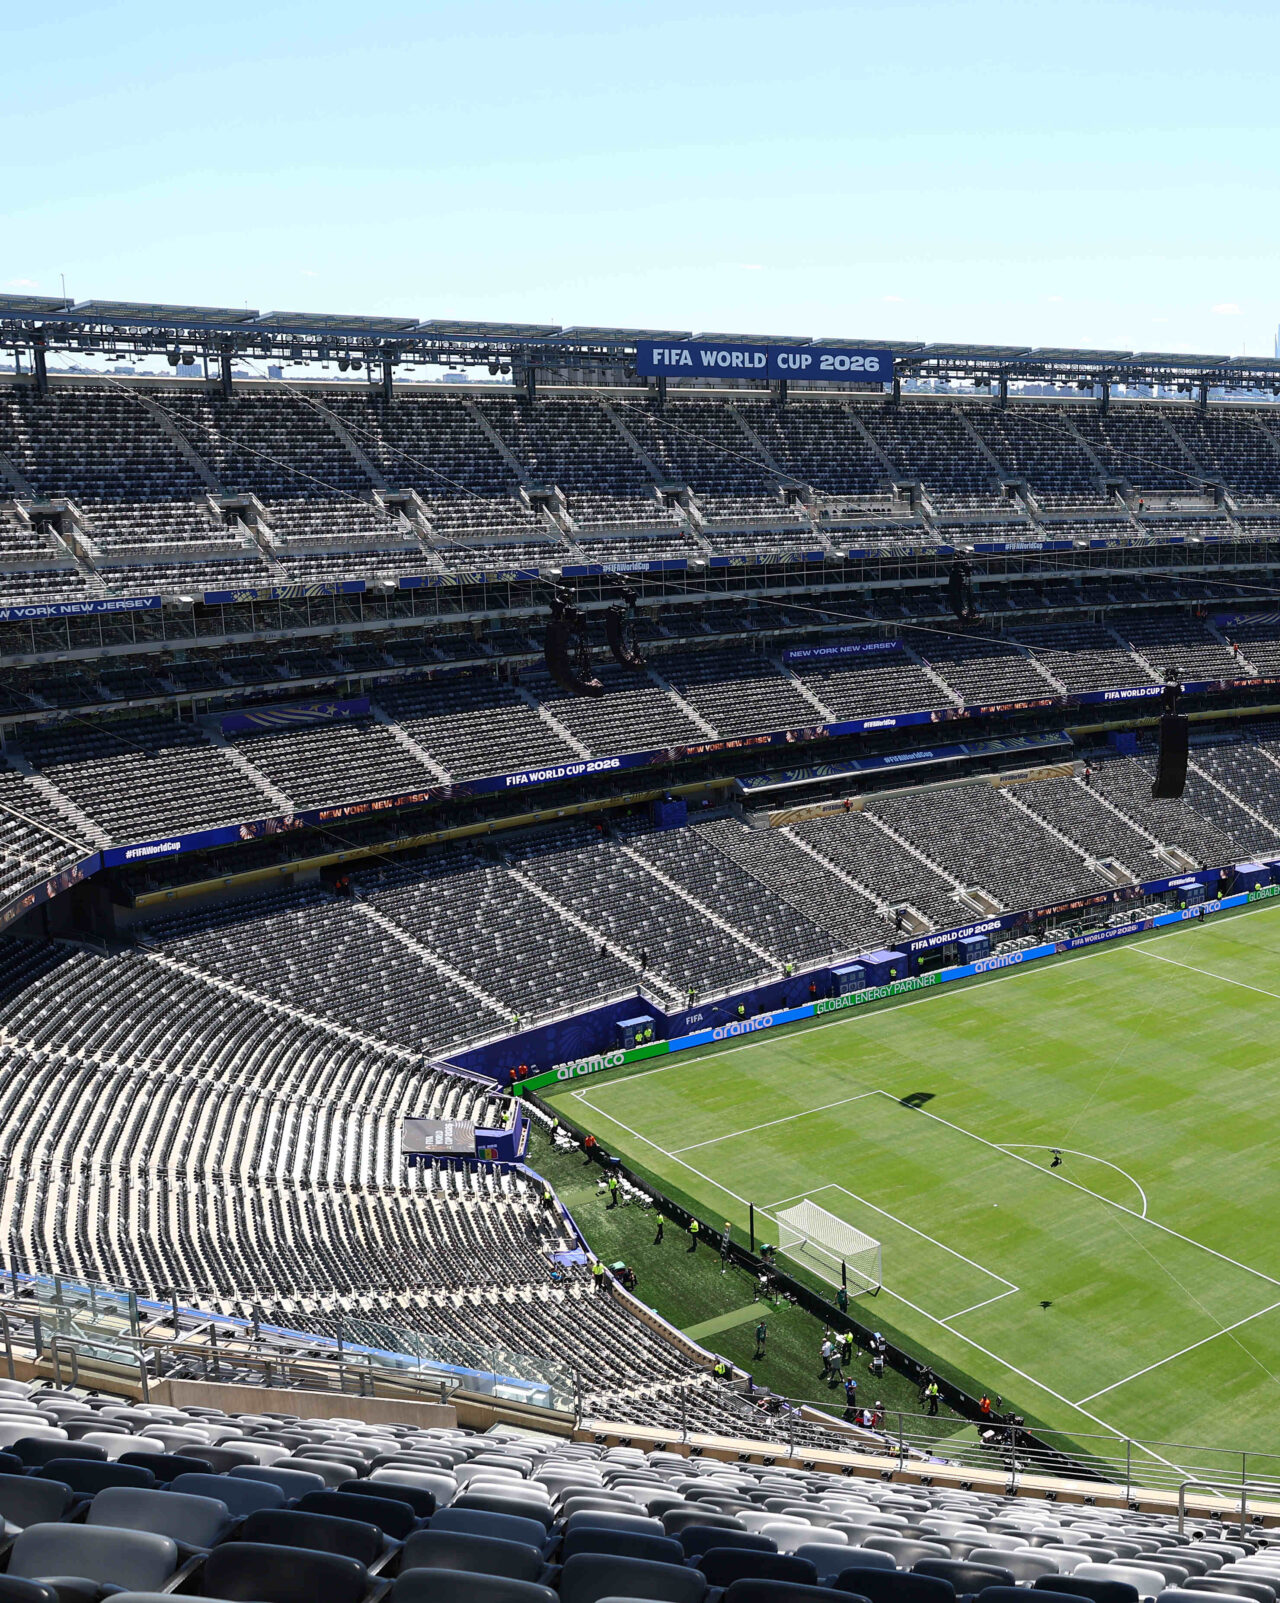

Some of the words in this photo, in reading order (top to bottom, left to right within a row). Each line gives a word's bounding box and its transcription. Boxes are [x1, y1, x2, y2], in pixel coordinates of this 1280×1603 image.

[653, 348, 693, 366] FIFA
[700, 350, 766, 368] WORLD
[777, 353, 812, 369] CUP
[820, 354, 880, 372] 2026
[1005, 542, 1043, 550] #FIFAWorldCup
[14, 607, 57, 616] YORK
[60, 604, 94, 613] NEW
[98, 599, 153, 610] JERSEY
[862, 642, 897, 651] JERSEY
[1104, 692, 1120, 700] FIFA
[1120, 689, 1146, 698] WORLD
[506, 774, 528, 786] FIFA
[529, 768, 565, 782] WORLD
[566, 764, 585, 775] CUP
[586, 759, 620, 772] 2026
[320, 808, 343, 820] NEW
[344, 804, 370, 816] YORK
[372, 799, 392, 810] NEW
[394, 793, 429, 807] JERSEY
[125, 842, 180, 859] #FIFAWorldCup
[1249, 887, 1273, 902] GLOBAL
[911, 941, 928, 951] FIFA
[929, 932, 957, 946] WORLD
[958, 928, 974, 938] CUP
[974, 920, 1001, 934] 2026
[1084, 933, 1105, 943] WORLD
[1117, 924, 1137, 935] 2026
[975, 952, 1023, 973] aramco
[816, 994, 854, 1014] GLOBAL
[855, 986, 893, 1004] ENERGY
[894, 975, 935, 994] PARTNER
[686, 1013, 703, 1025] FIFA
[713, 1016, 773, 1039] aramco
[557, 1053, 624, 1080] aramco
